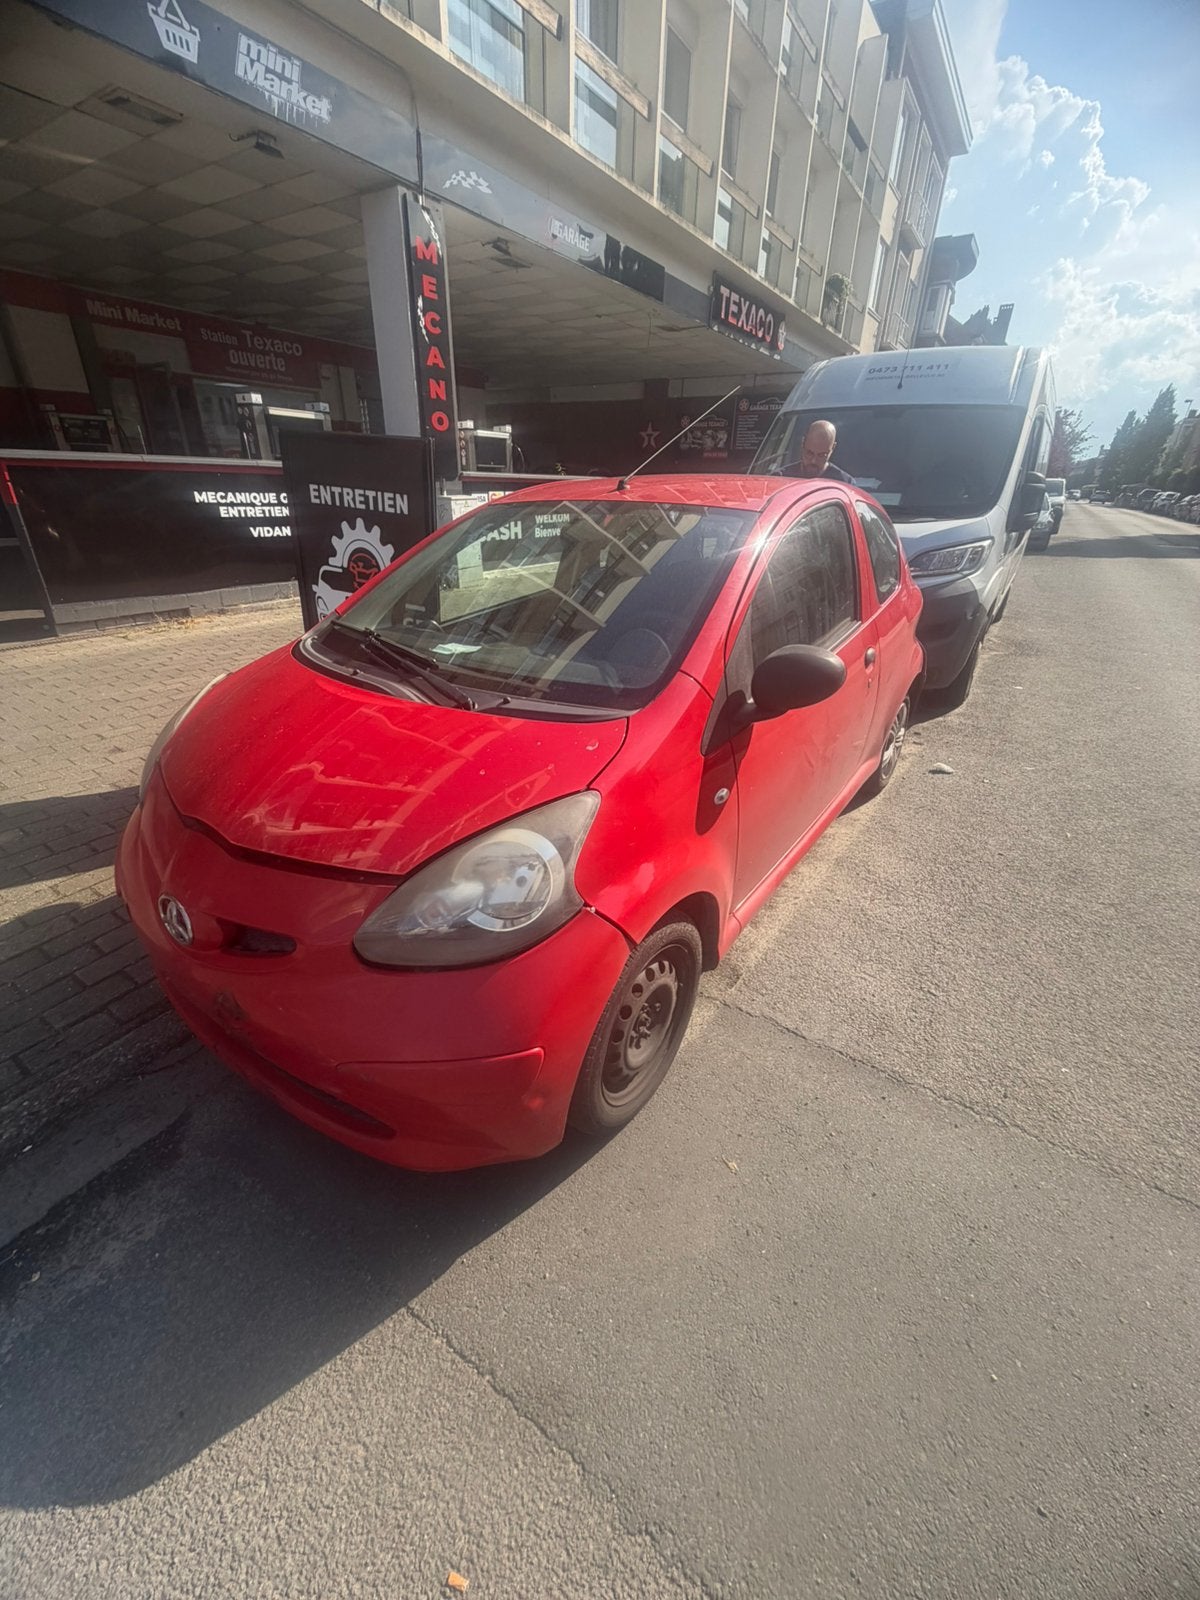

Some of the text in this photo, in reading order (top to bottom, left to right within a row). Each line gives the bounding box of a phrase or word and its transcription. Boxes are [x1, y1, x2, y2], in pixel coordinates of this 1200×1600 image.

[238, 33, 301, 82] mini
[236, 53, 332, 122] Market
[557, 222, 591, 252] GARAGE
[86, 300, 182, 331] Mini Market
[720, 285, 774, 343] TEXACO
[200, 328, 302, 356] Station Texaco
[416, 235, 449, 432] MECANO
[868, 366, 898, 374] 0473
[193, 491, 278, 505] MECANIQUE
[219, 506, 290, 518] ENTRETIEN
[309, 483, 409, 515] ENTRETIEN
[249, 526, 292, 538] VIDAN
[535, 513, 570, 524] WELKOM
